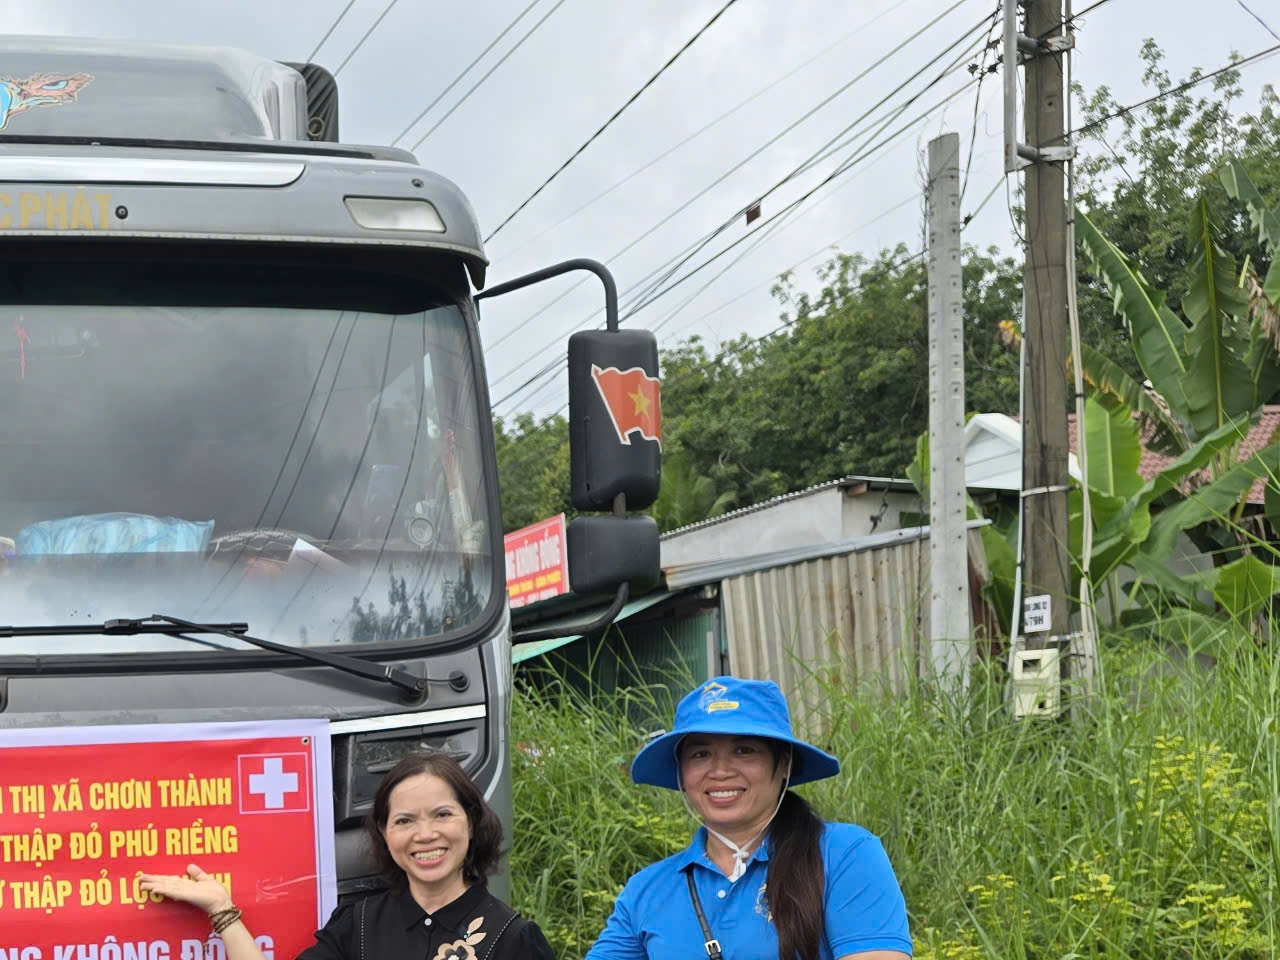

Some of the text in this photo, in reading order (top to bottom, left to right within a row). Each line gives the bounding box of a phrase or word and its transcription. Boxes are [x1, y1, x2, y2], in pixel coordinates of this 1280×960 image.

[8, 785, 45, 819] THỊ
[52, 778, 83, 812] XÃ
[89, 779, 151, 810] CHƠN
[158, 774, 231, 807] THÀNH
[0, 828, 62, 867] THẬP
[70, 822, 102, 859] ĐỎ
[110, 824, 158, 857] PHÚ
[166, 819, 237, 855] RIỀNG
[10, 875, 72, 913] THẬP
[80, 869, 112, 906] ĐỎ
